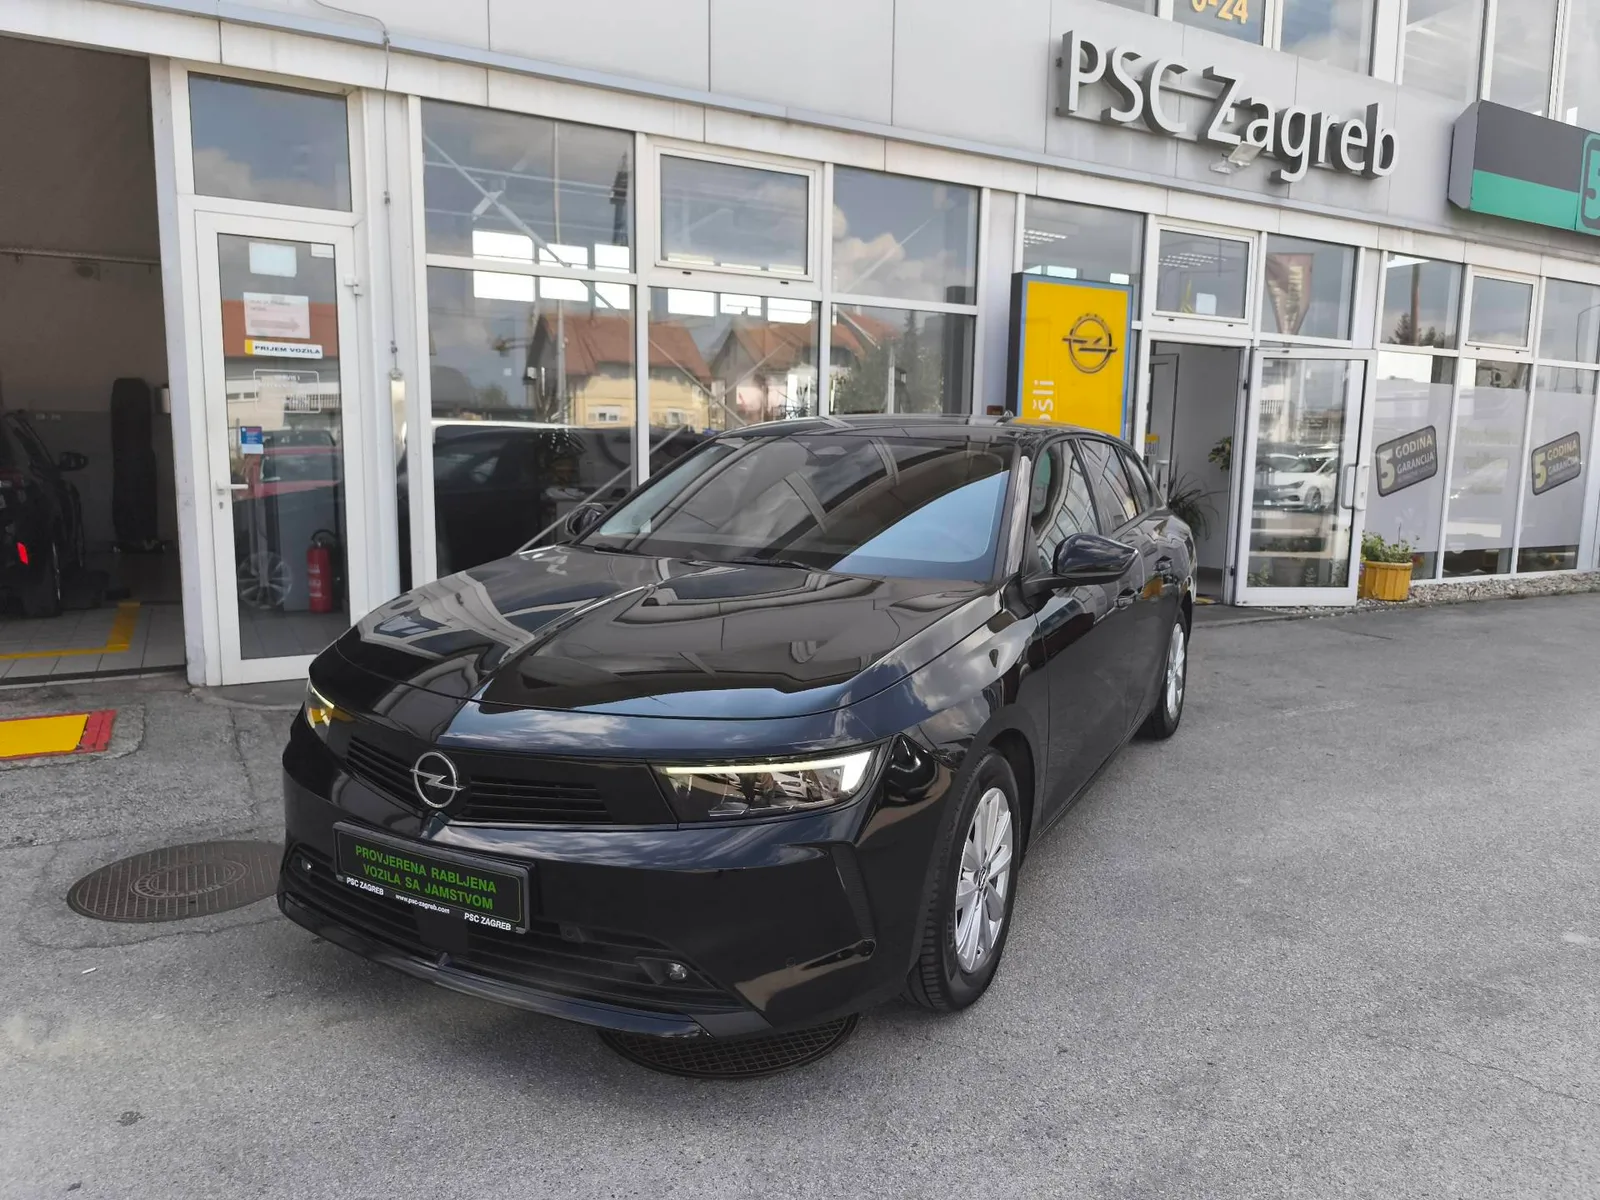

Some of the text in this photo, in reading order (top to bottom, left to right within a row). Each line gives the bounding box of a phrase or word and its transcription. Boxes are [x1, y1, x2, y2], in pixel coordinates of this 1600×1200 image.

[1063, 31, 1400, 183] PSC Zagreb
[254, 345, 288, 353] PRIJEM
[1379, 448, 1396, 490] 5
[1395, 434, 1434, 459] GODINA
[1396, 451, 1435, 475] GARANCIJA
[1534, 439, 1578, 489] 5 GODINA
[346, 876, 385, 896] PSC ZAGREB
[355, 845, 497, 894] PROVJERENA RABLJENA
[362, 863, 494, 910] VOZILA SA JAMSTVOM
[395, 894, 450, 914] www.psc-zagreb.com
[464, 912, 512, 931] PSC ZAGREB
